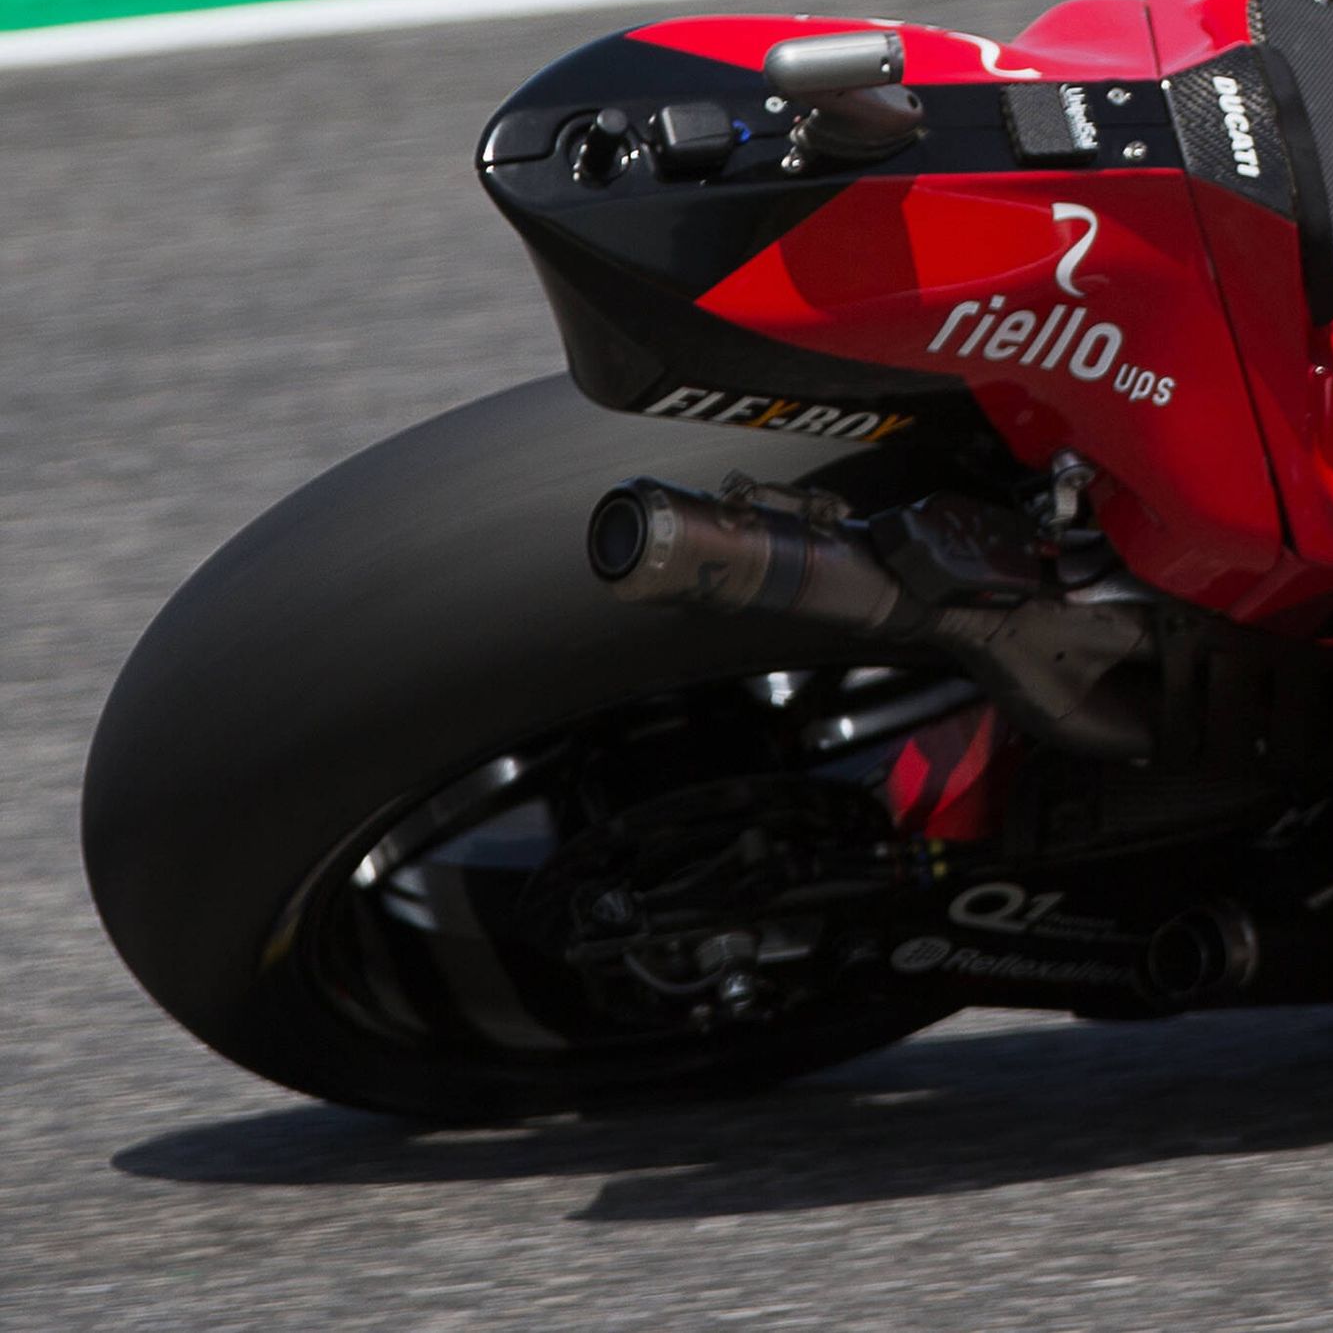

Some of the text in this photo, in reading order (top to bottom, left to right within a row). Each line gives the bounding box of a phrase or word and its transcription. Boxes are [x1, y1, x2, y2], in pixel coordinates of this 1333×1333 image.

[1211, 75, 1263, 178] DUCATI
[926, 295, 1178, 408] riello ups
